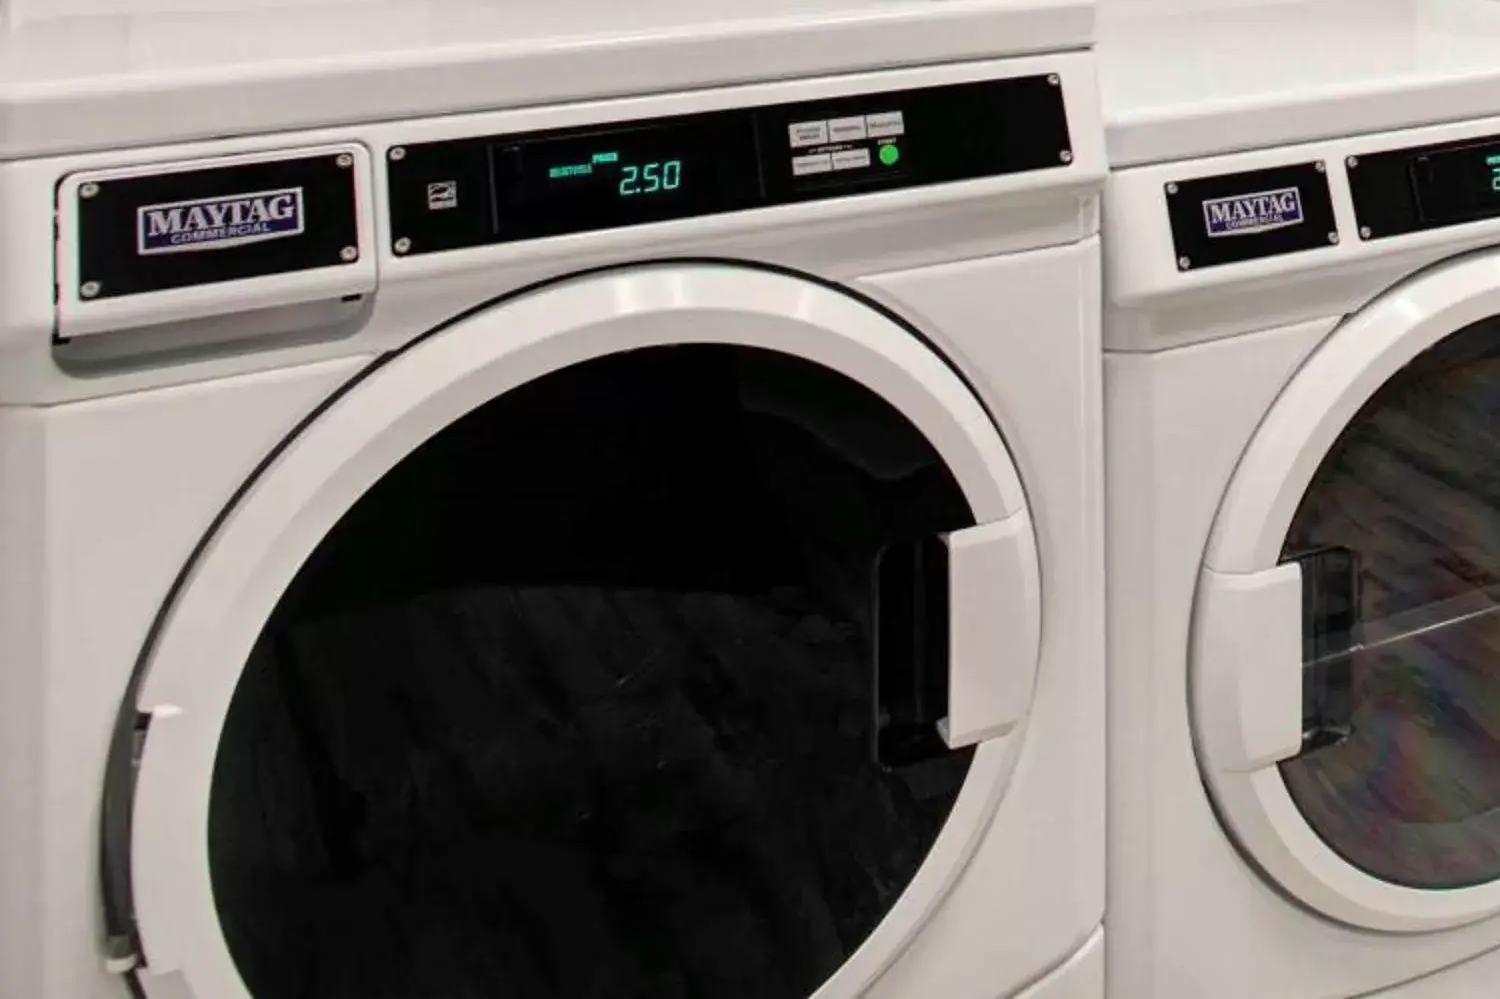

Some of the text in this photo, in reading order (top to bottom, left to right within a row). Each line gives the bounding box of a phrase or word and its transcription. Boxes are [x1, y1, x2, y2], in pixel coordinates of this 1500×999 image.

[619, 159, 681, 196] 2.50
[147, 194, 295, 237] MAYTAG
[1210, 192, 1296, 224] MAYTAG
[170, 221, 271, 245] COMMERCIAL
